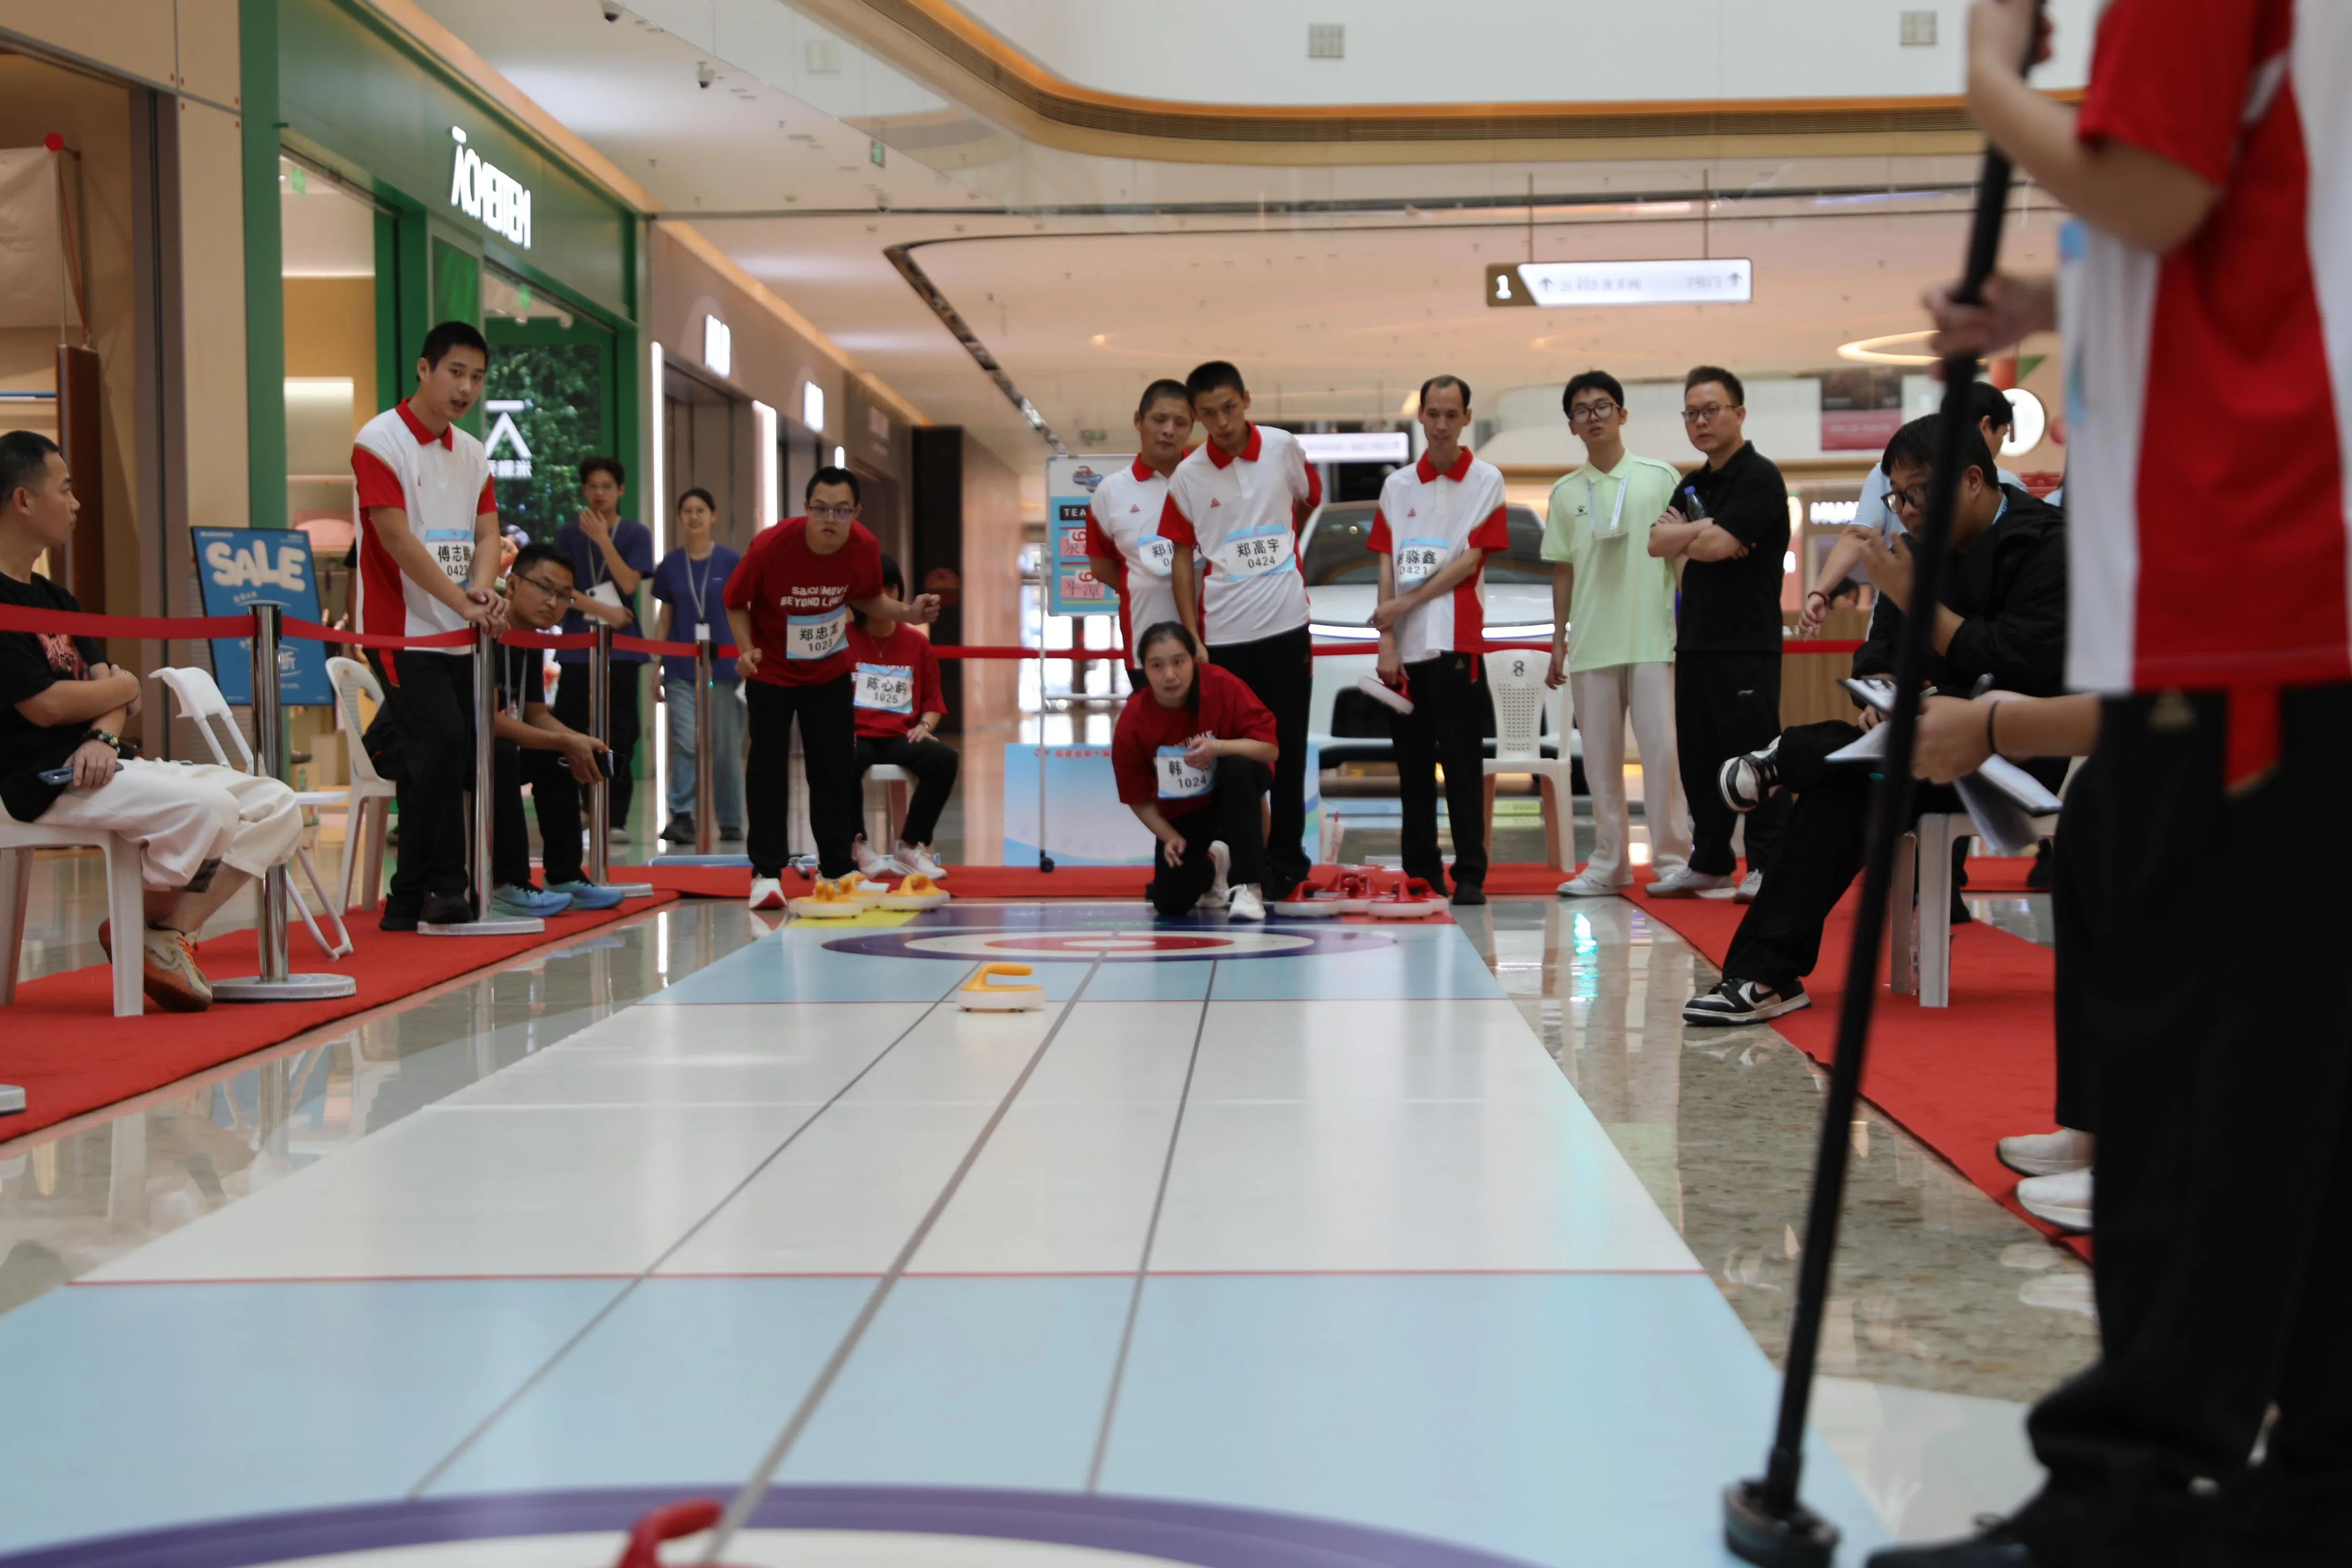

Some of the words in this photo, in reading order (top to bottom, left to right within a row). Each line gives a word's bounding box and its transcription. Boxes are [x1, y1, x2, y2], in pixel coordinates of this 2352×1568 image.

[1495, 275, 1512, 299] 1
[1063, 508, 1086, 516] TEA
[1237, 538, 1279, 557] 郑高宇
[205, 540, 306, 592] SALE
[1248, 555, 1276, 568] 0424
[447, 564, 468, 576] 0423
[1399, 566, 1427, 575] 0421
[780, 596, 820, 607] BEYOND
[808, 638, 832, 652] 1023
[875, 692, 898, 704] 1025
[1178, 775, 1207, 788] 1024
